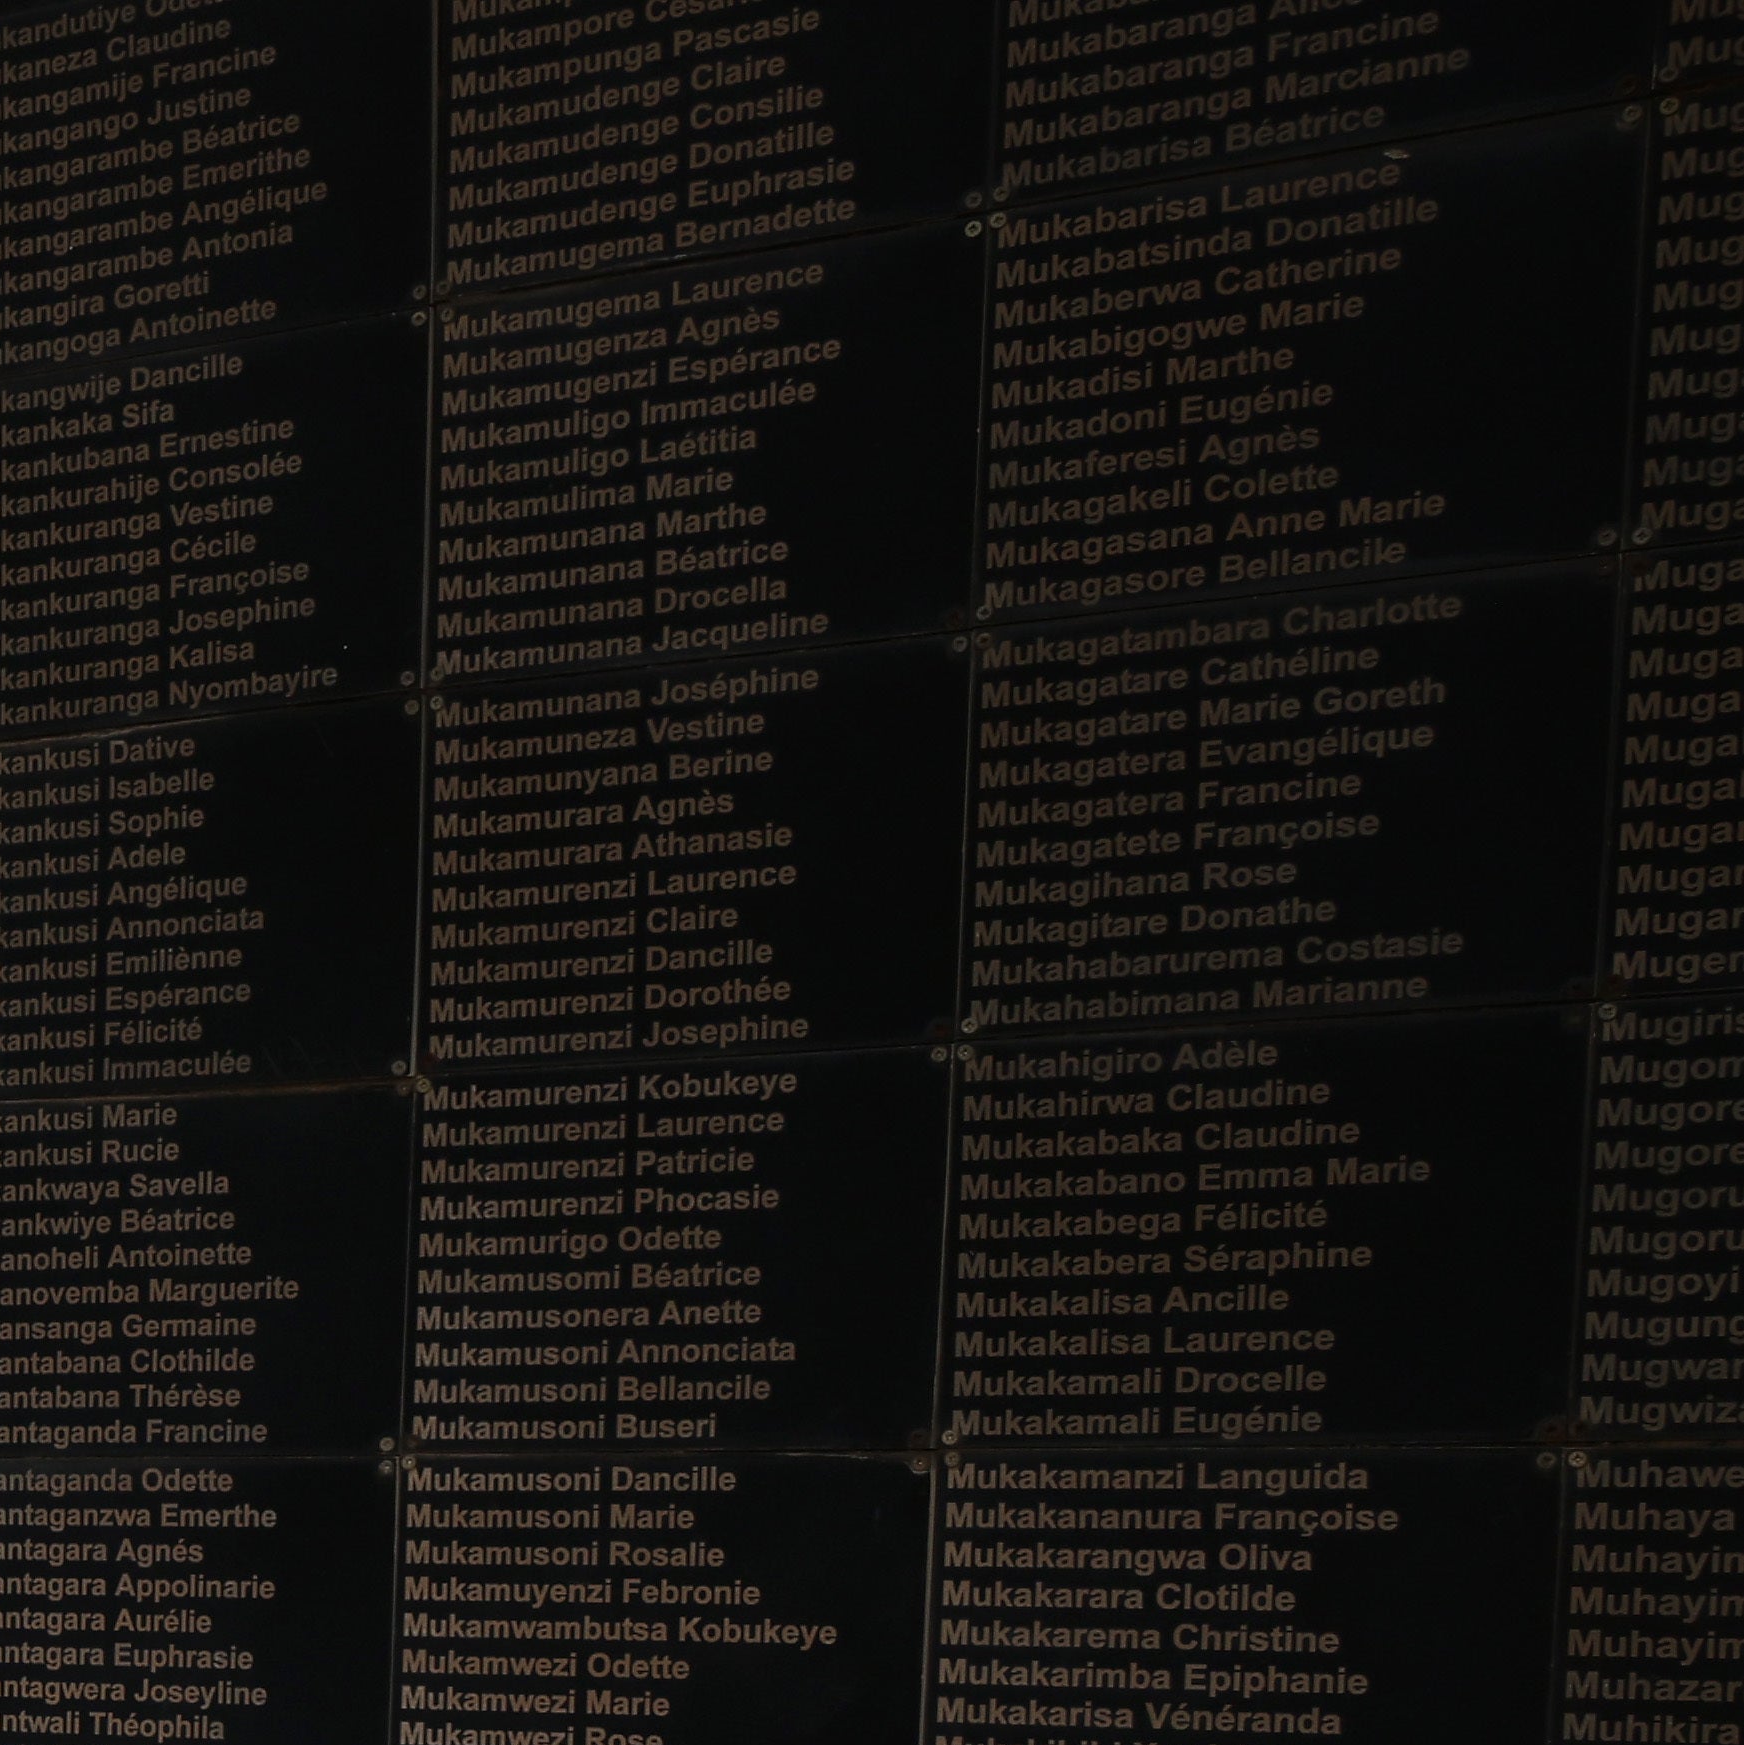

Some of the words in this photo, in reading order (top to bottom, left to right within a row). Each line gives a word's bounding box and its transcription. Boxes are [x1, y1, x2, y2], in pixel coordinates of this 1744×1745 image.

[449, 154, 678, 212] Mukamudenge
[689, 121, 835, 170] Donatille
[181, 182, 328, 226] Angélique
[996, 226, 1252, 290] Mukabatsinda
[1266, 196, 1439, 247] Donatille
[993, 314, 1247, 370] Mukabigogwe
[1260, 292, 1365, 331] Marie
[159, 419, 295, 458] Ernestine
[990, 399, 1167, 450] Mukadoni
[439, 484, 635, 528] Mukamulima
[646, 467, 734, 501] Marie
[986, 523, 1213, 570] Mukagasana
[1225, 510, 1326, 542] Anne
[1339, 489, 1446, 528] Marie
[169, 640, 255, 670] Kalisa
[433, 804, 624, 839] Mukamurara
[632, 788, 734, 826] Agnès
[433, 842, 623, 876] Mukamurara
[631, 821, 793, 860] Athanasie
[106, 946, 243, 976] Emiliènne
[972, 946, 1283, 987] Mukahabarurema
[1296, 927, 1464, 965] Costasie
[965, 1047, 1163, 1082] Mukahigiro
[960, 1168, 1186, 1201] Mukakabano
[1198, 1163, 1313, 1191] Emma
[1326, 1154, 1431, 1186] Marie
[957, 1248, 1171, 1280] Mukakabera
[1183, 1240, 1373, 1277] Séraphine
[149, 1275, 300, 1308] Marguerite
[416, 1305, 650, 1331] Mukamusonera
[658, 1300, 762, 1326] Anette
[160, 1502, 278, 1528] Emerthe
[945, 1502, 1202, 1530] Mukakananura
[1214, 1502, 1399, 1537] Françoise
[944, 1540, 1206, 1577] Mukakarangwa
[1218, 1543, 1312, 1571] Oliva
[114, 1573, 276, 1603] Appolinarie
[404, 1576, 612, 1609] Mukamuyenzi
[622, 1578, 761, 1606] Febronie
[403, 1612, 668, 1642] Mukamwambutsa
[678, 1616, 837, 1651] Kobukeye
[938, 1657, 1171, 1690] Mukakarimba
[1184, 1663, 1369, 1699] Epiphanie
